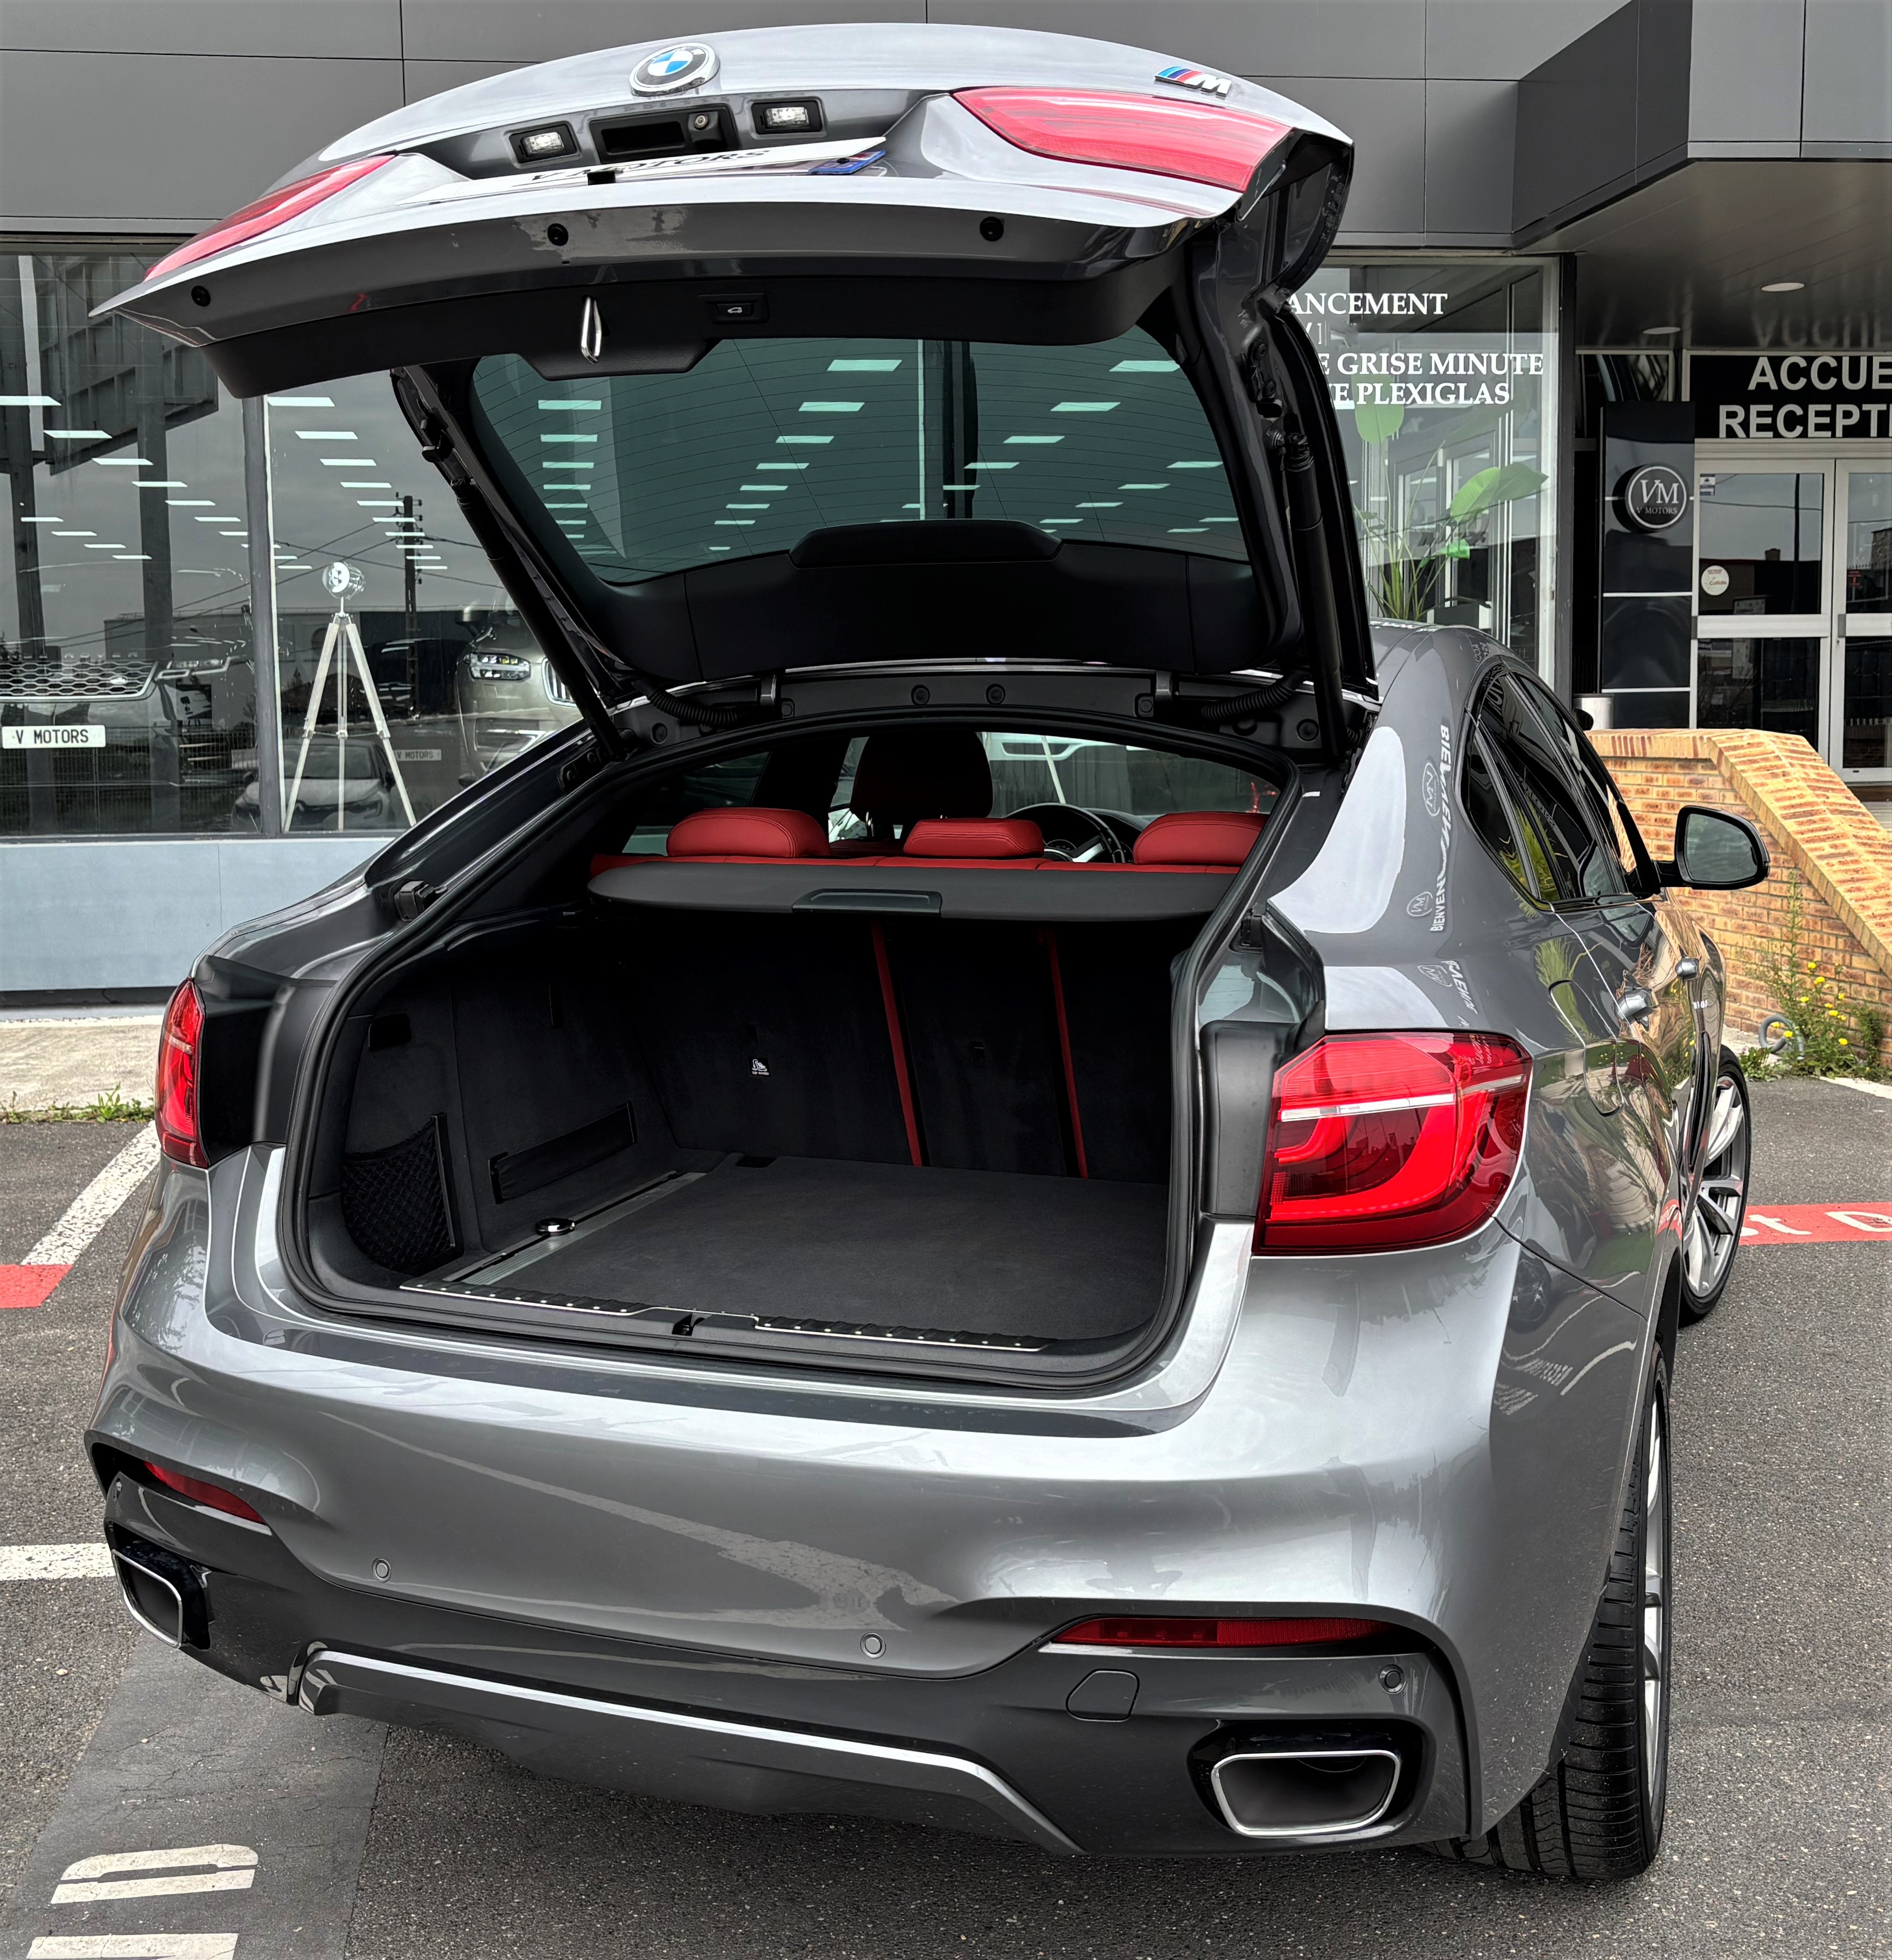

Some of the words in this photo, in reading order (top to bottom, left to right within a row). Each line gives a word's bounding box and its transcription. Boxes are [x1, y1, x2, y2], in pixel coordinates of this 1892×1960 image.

[1287, 292, 1448, 315] ANCEMENT
[1337, 353, 1422, 375] GRISE
[1429, 353, 1544, 375] MINUTE
[1748, 355, 1892, 390] ACCUE
[1328, 383, 1349, 405] E
[1357, 382, 1510, 405] PLEXIGLAS
[1640, 479, 1679, 504] VM
[16, 729, 24, 744] V
[33, 729, 88, 744] MOTORS
[405, 751, 434, 759] MOTORS
